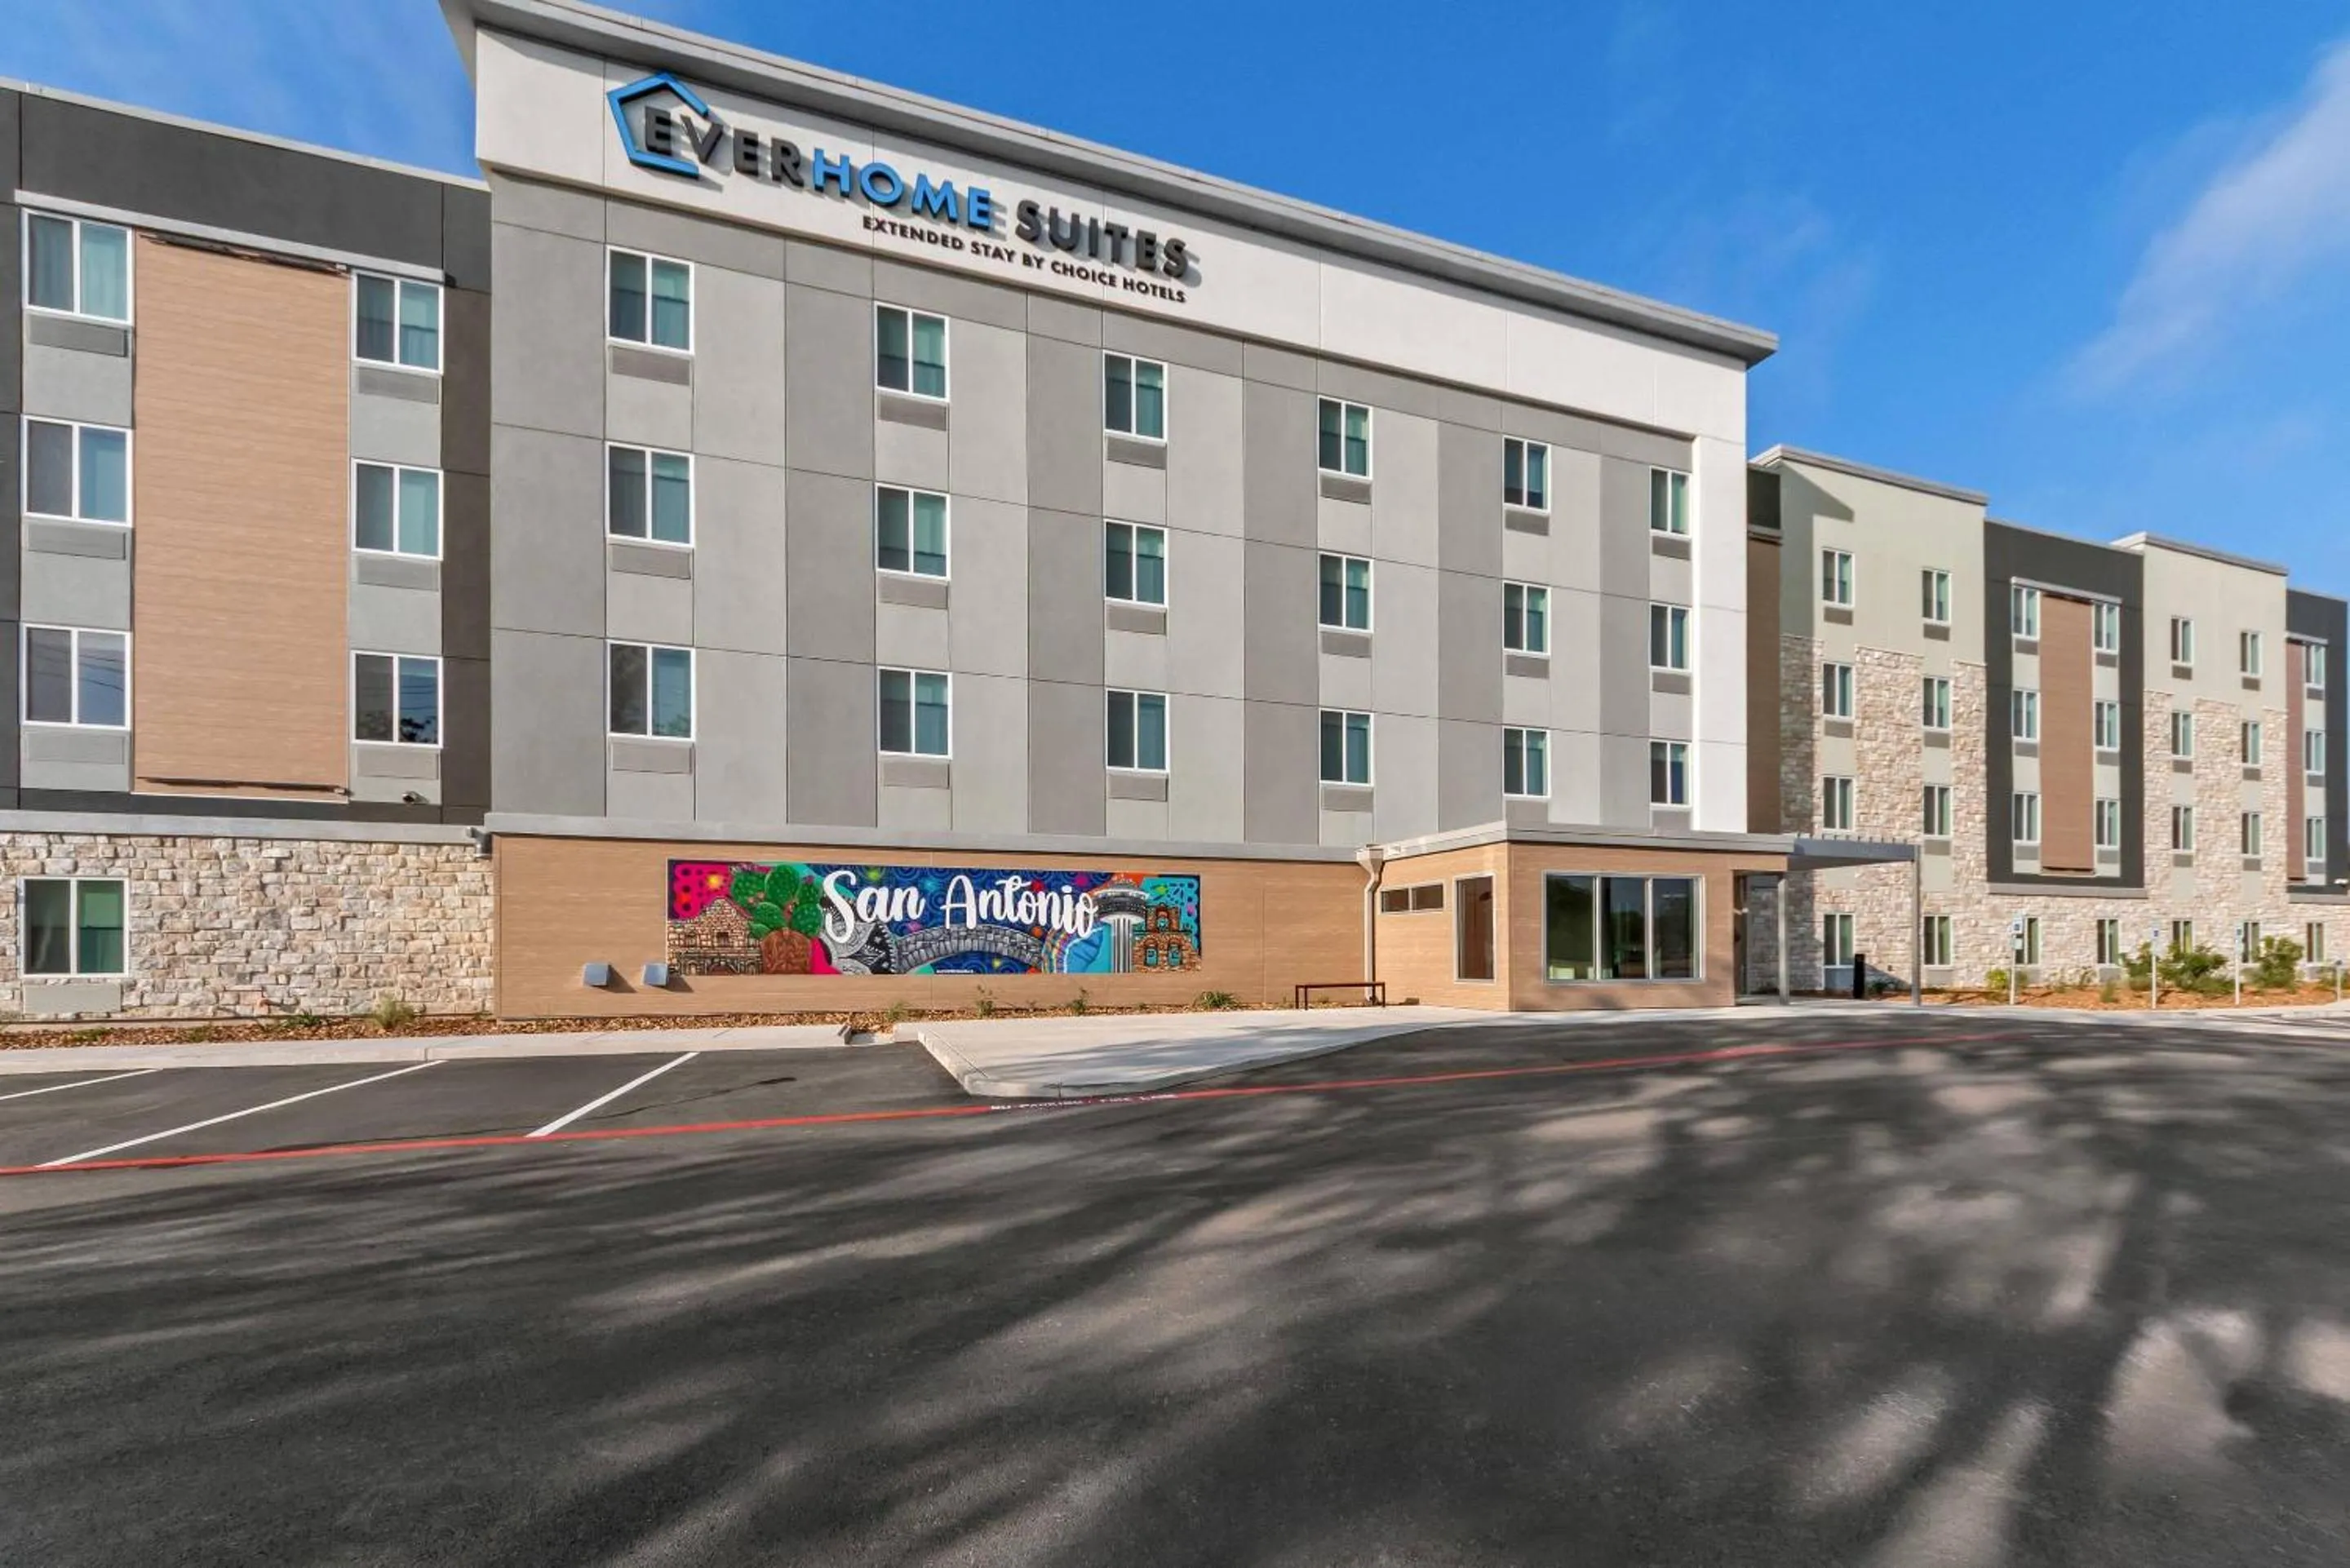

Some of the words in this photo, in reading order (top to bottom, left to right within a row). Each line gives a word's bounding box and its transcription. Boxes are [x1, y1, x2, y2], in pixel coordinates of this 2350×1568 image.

[643, 104, 993, 231] EVERHOME
[1015, 199, 1189, 278] SUITES
[862, 215, 965, 250] EXTENDED
[970, 241, 1017, 263] STAY
[1022, 253, 1045, 269] BY
[1050, 260, 1118, 287] CHOICE
[1123, 277, 1186, 303] HOTELS
[821, 869, 926, 944] San
[939, 874, 1100, 938] Antonio
